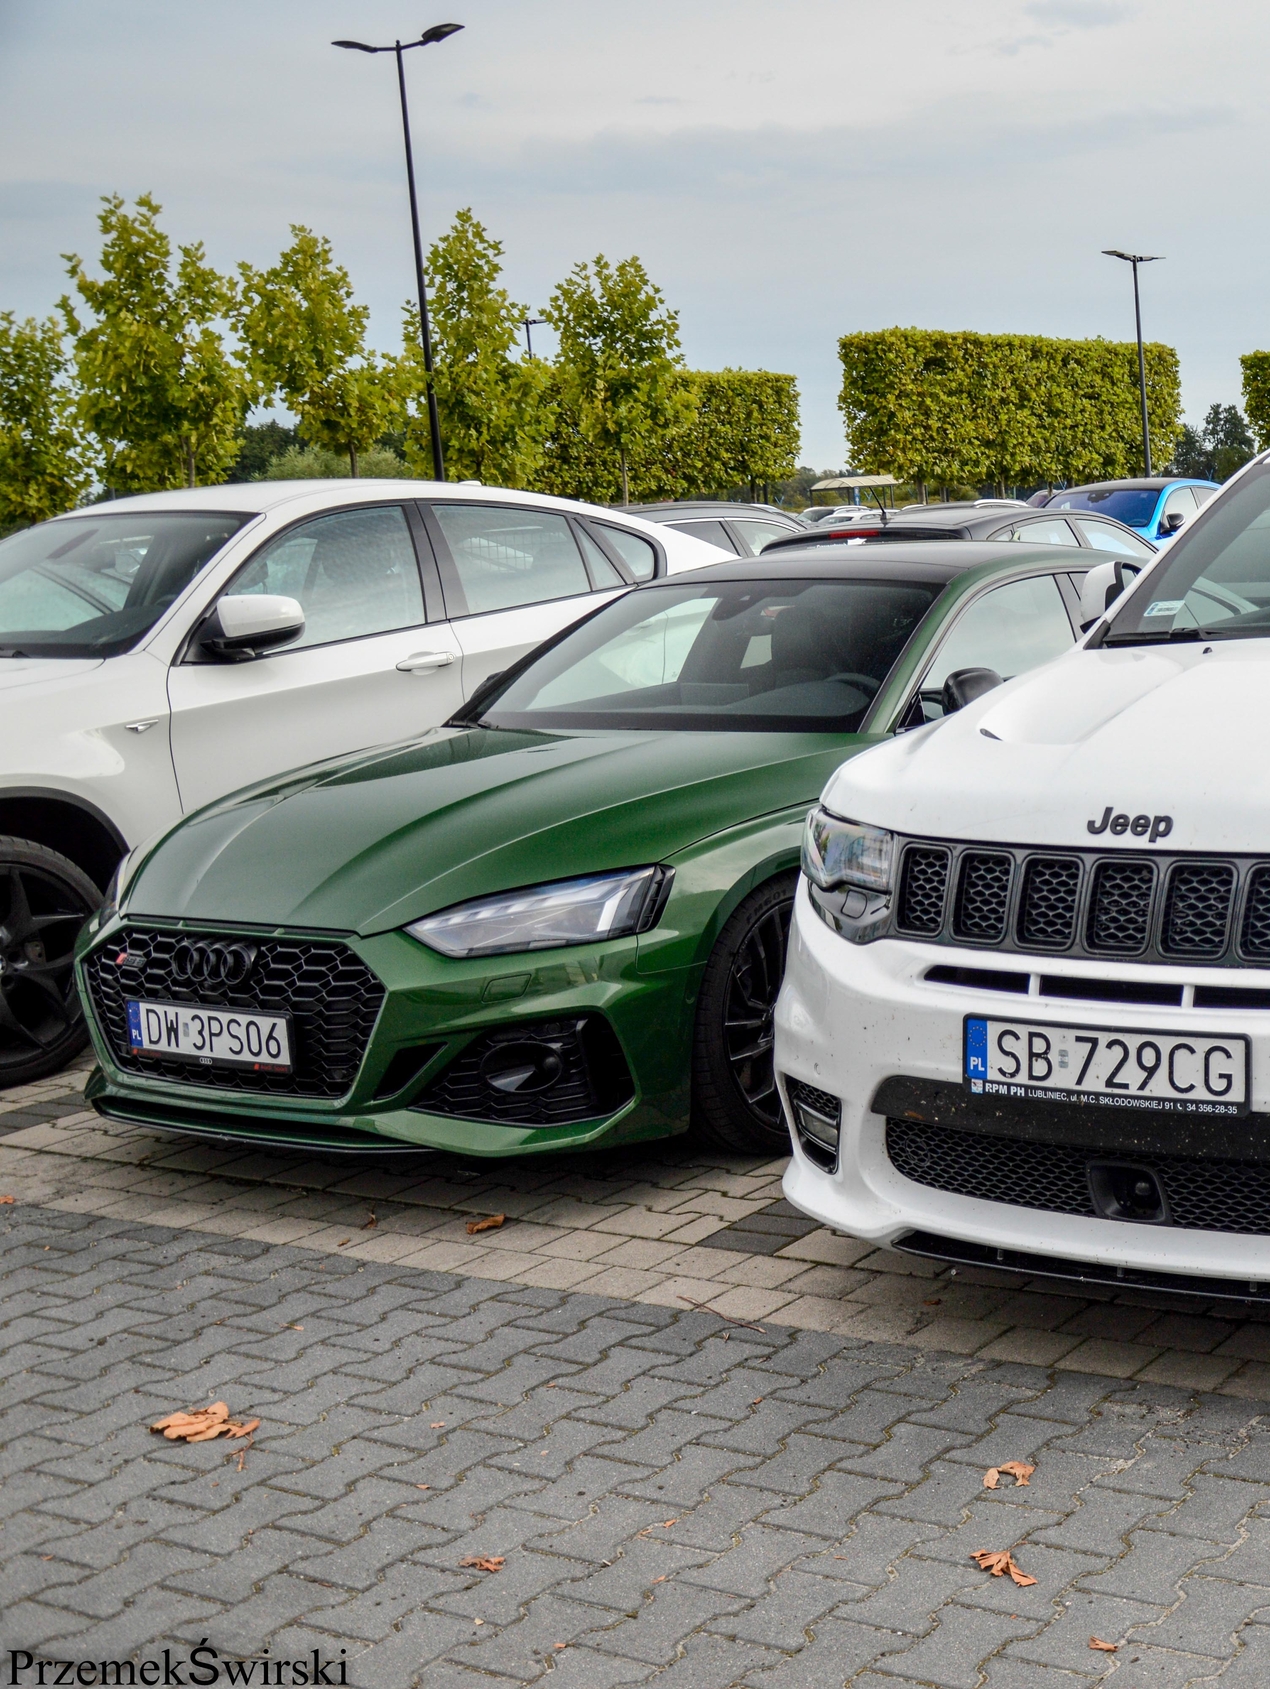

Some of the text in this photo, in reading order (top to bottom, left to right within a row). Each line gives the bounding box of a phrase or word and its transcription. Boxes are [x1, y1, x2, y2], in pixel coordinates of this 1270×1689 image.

[1087, 807, 1173, 843] Jeep
[132, 1029, 141, 1040] PL
[146, 1008, 281, 1059] DW 3PS06
[970, 1056, 985, 1071] PL
[997, 1029, 1233, 1097] SB 729CG
[985, 1082, 1007, 1095] RPM
[1010, 1085, 1025, 1097] PH
[1028, 1088, 1069, 1102] LUBLINIEC,
[1081, 1094, 1097, 1104] M.C.
[1099, 1096, 1163, 1110] SKŁODOWSKIEJ
[1164, 1102, 1174, 1110] 91
[1186, 1103, 1196, 1111] 34
[1198, 1104, 1238, 1114] 356-28-35
